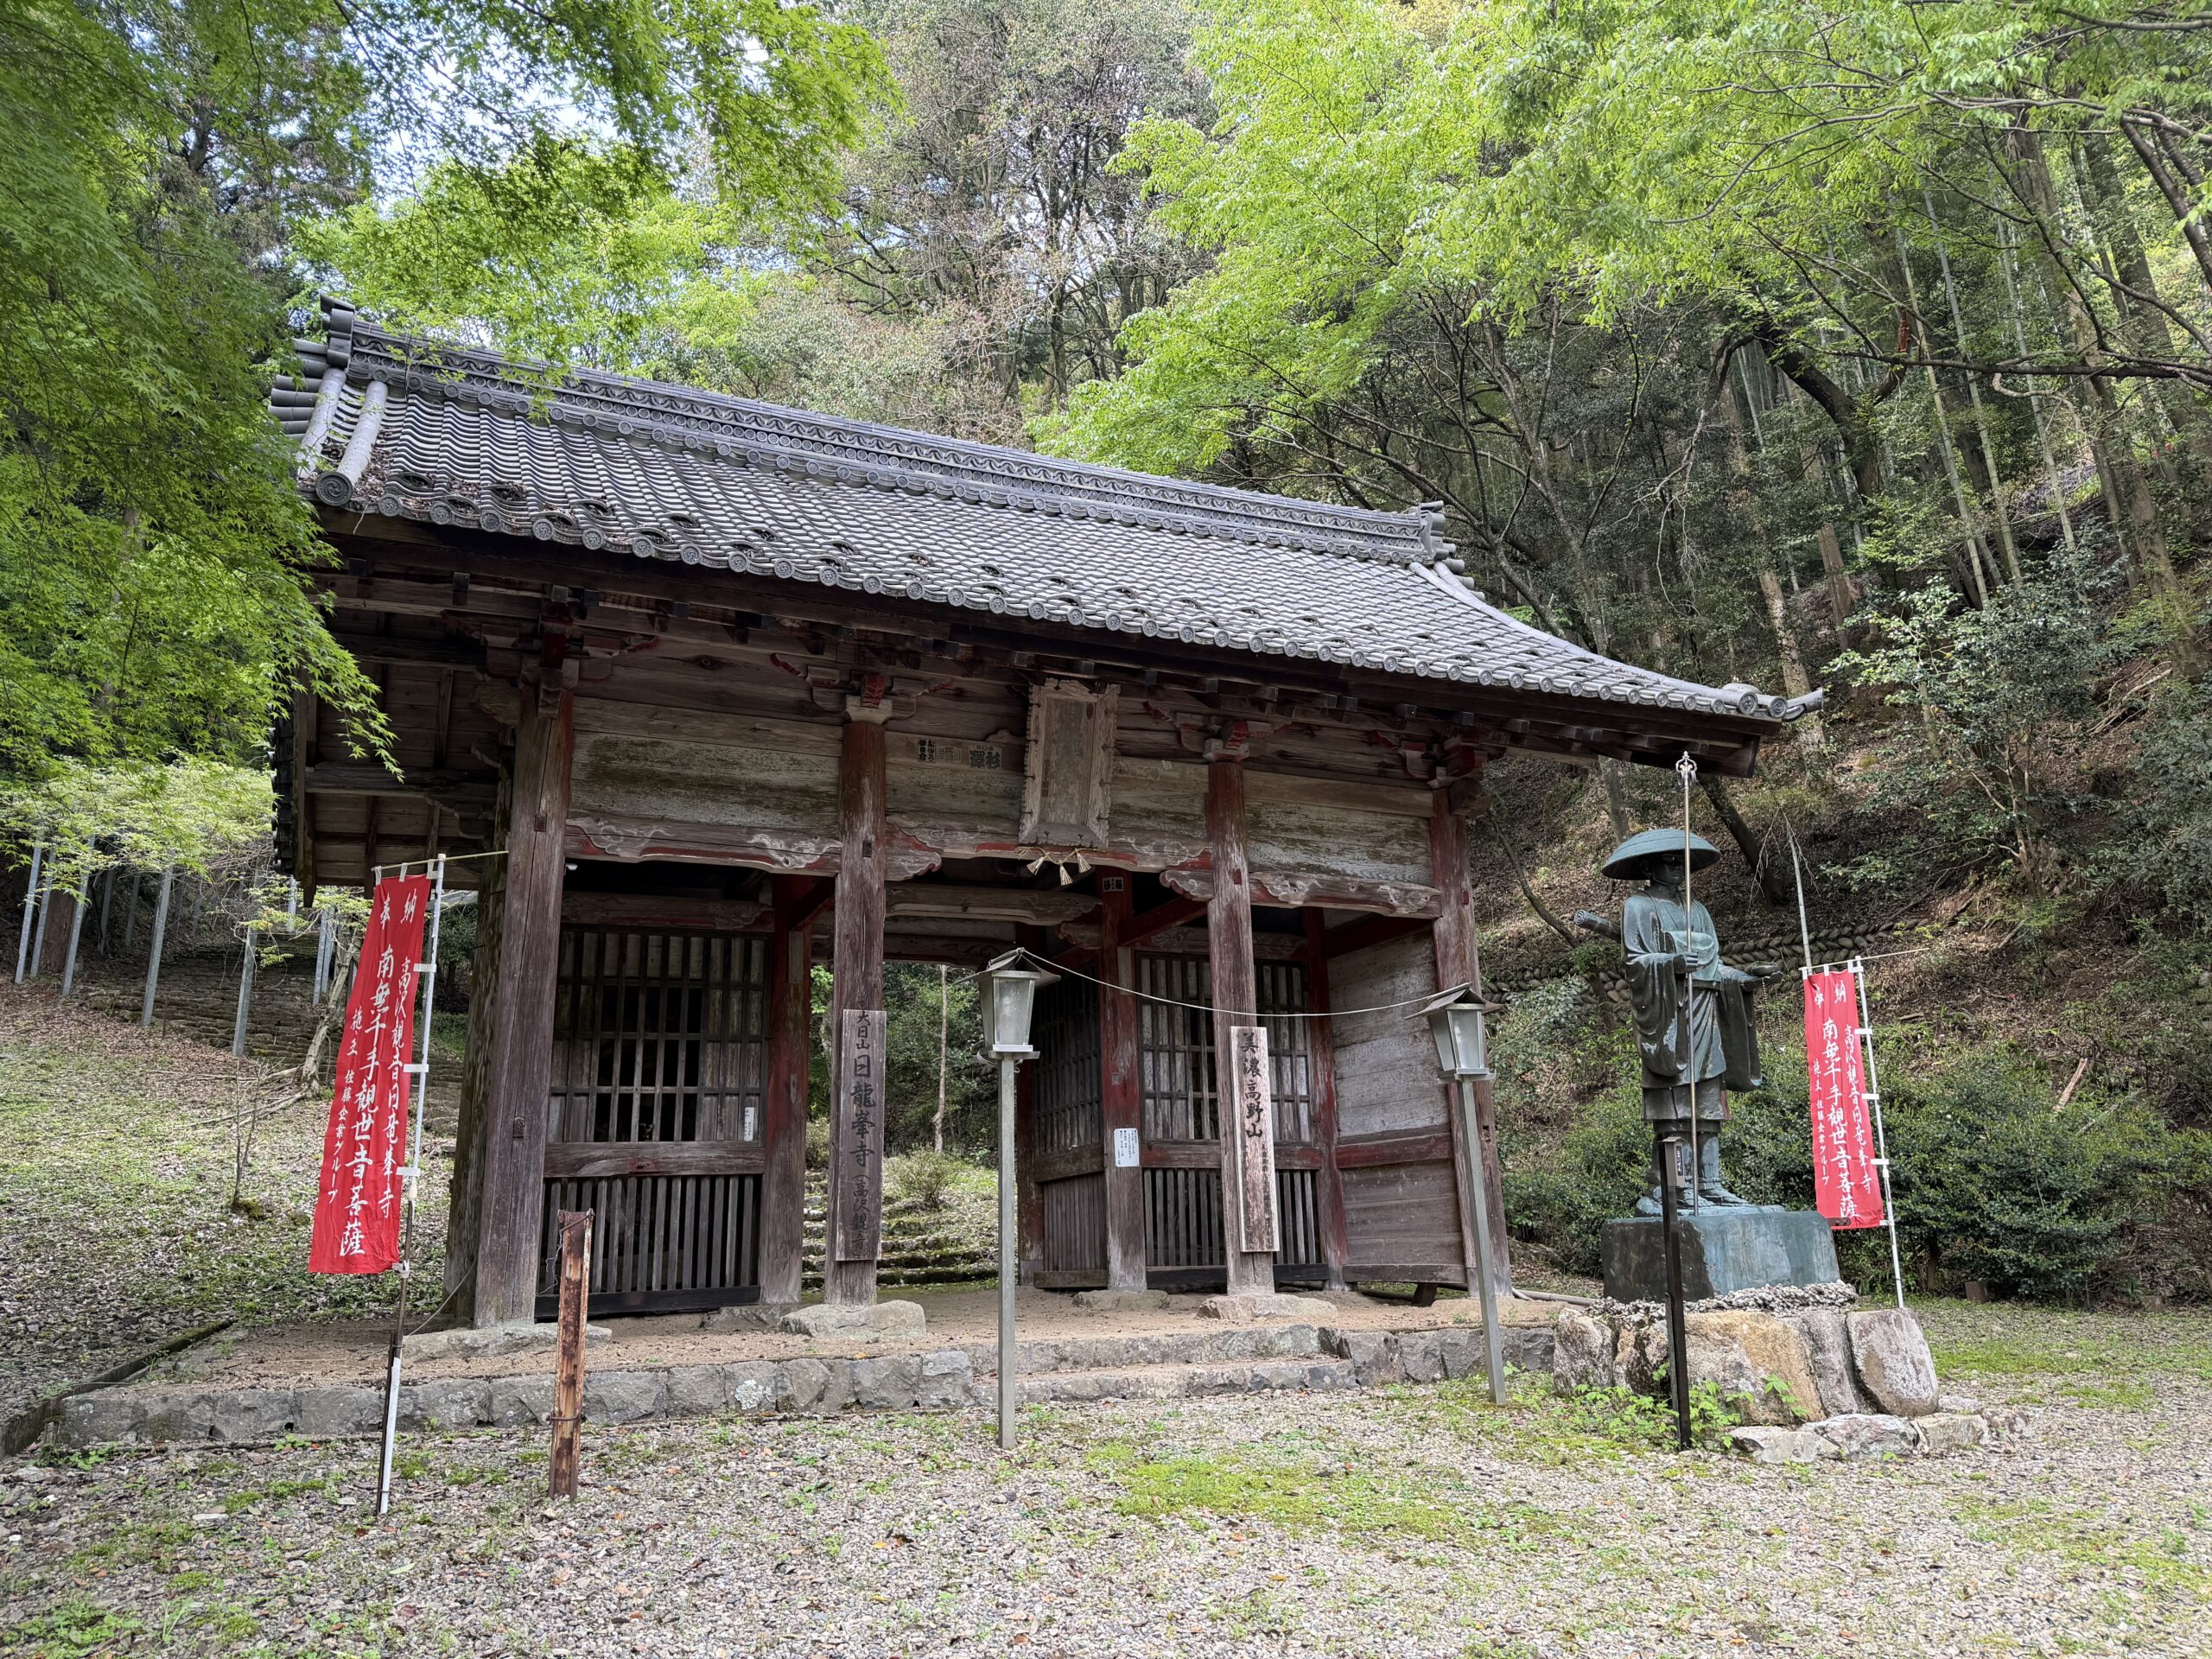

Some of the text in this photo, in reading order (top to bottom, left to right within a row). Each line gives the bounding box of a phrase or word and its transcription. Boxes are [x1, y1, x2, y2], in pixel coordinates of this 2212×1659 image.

[340, 943, 395, 1256] 南無千手観世音菩薩
[1241, 1032, 1264, 1139] 美濃高野山
